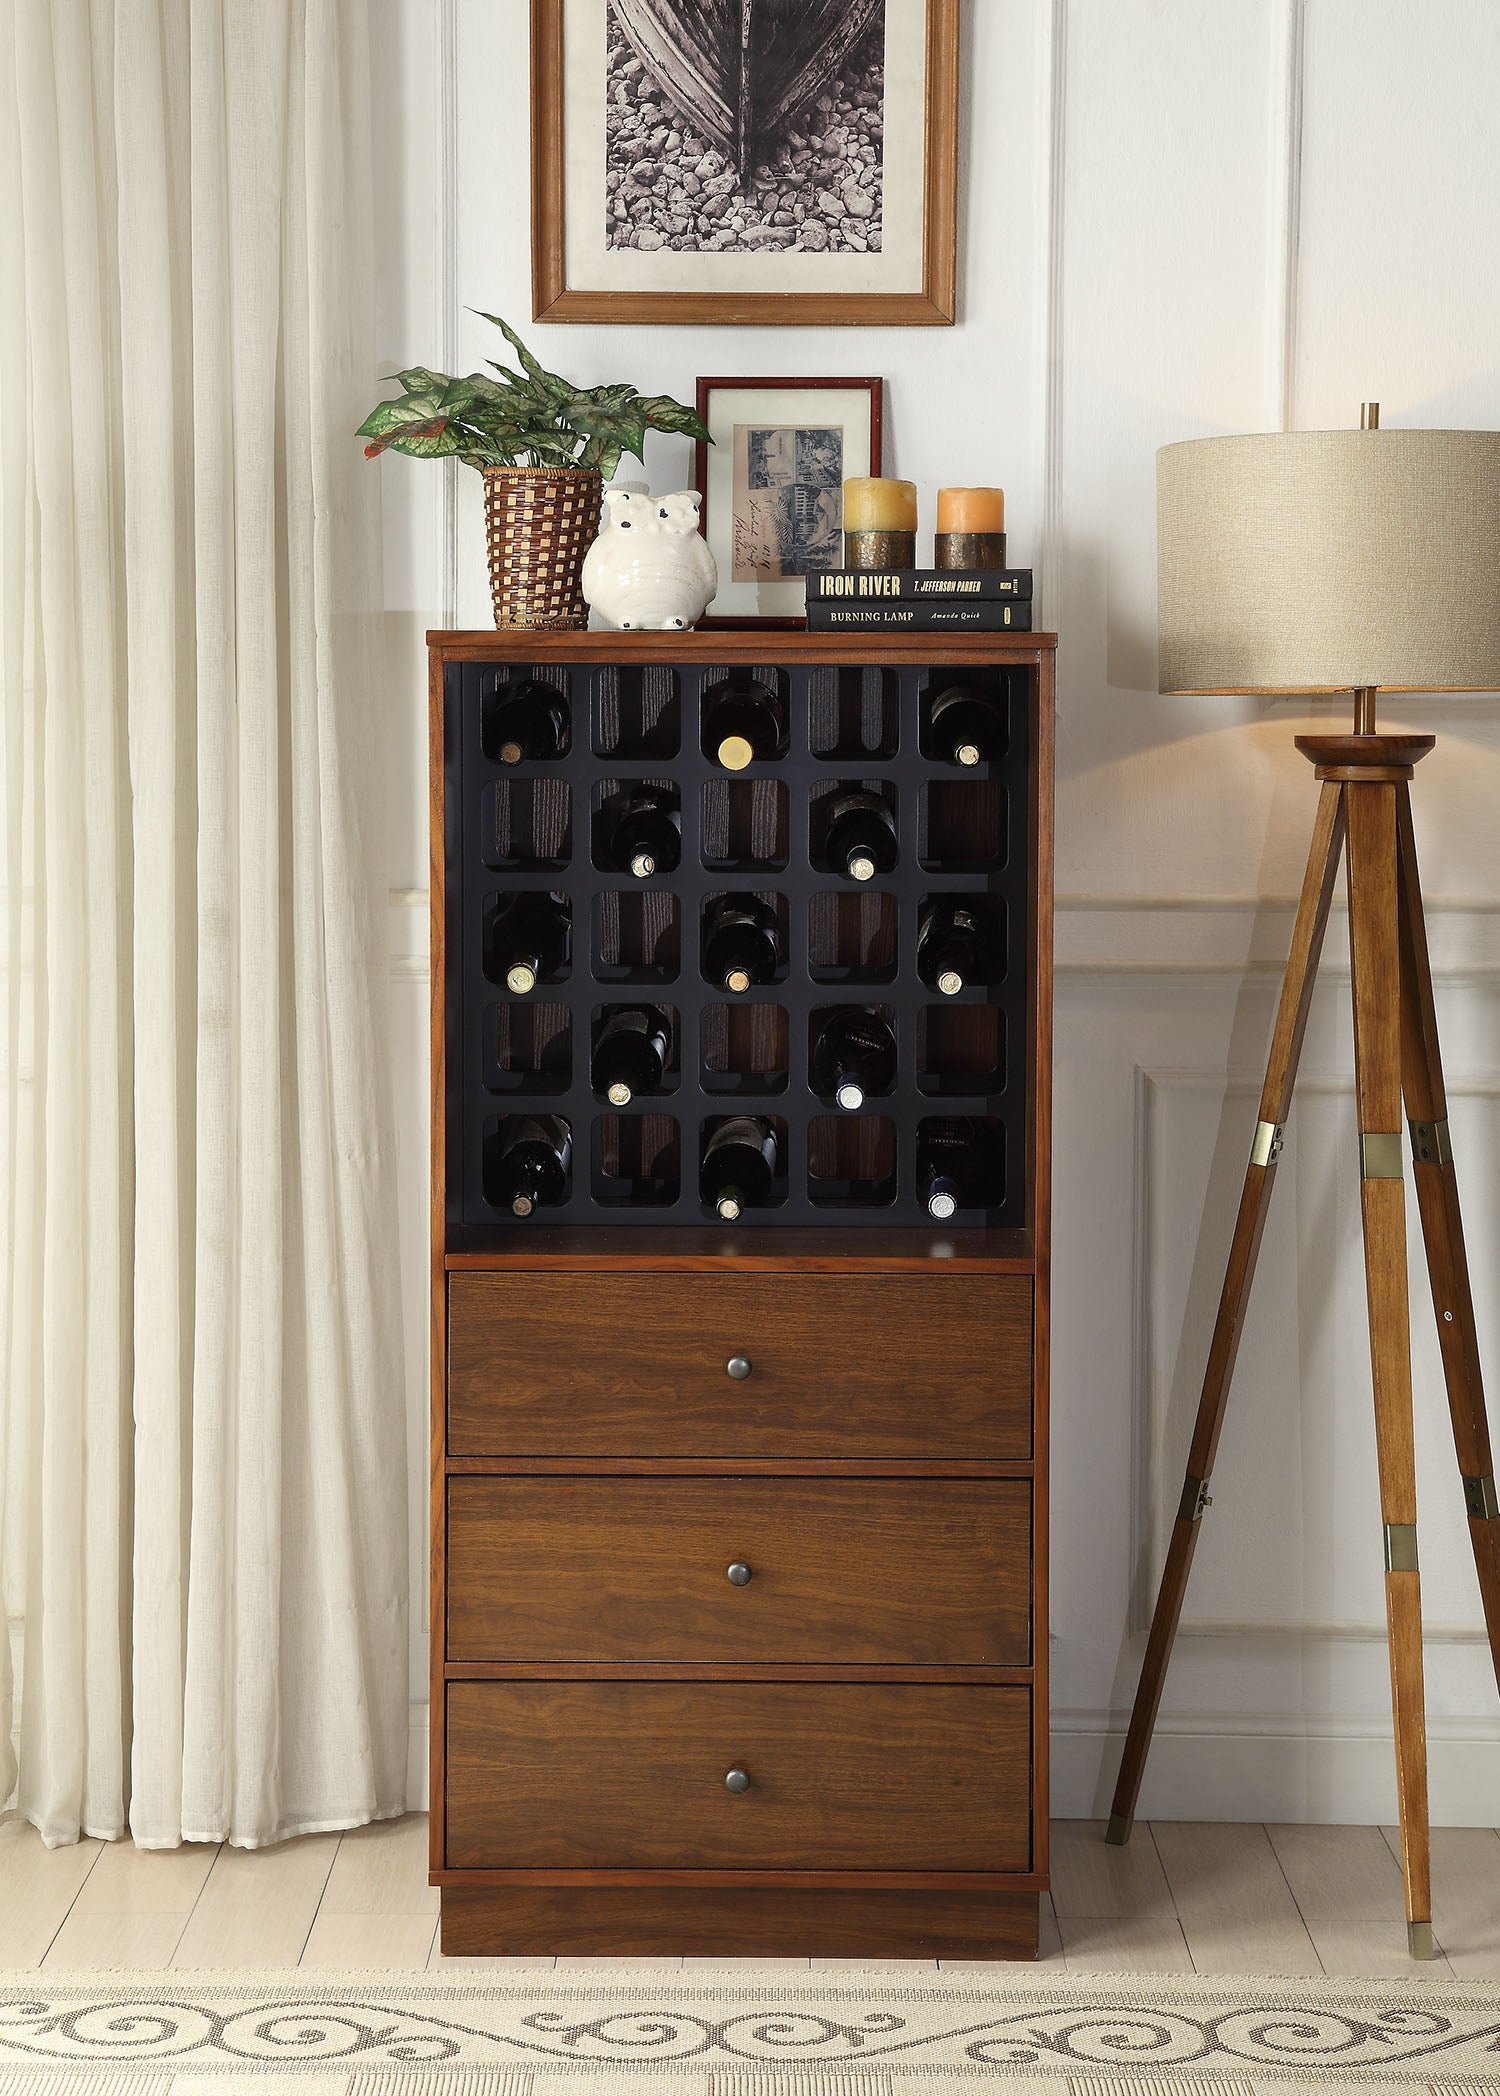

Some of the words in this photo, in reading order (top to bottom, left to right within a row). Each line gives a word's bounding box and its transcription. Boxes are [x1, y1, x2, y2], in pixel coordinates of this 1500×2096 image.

[819, 575, 855, 596] IRON
[858, 575, 901, 596] RIVER
[913, 580, 920, 593] T.
[920, 580, 957, 593] JEFFERSON
[956, 580, 982, 593] PARKER
[830, 611, 881, 622] BURNING
[883, 611, 914, 622] LAMP
[930, 611, 959, 620] Amanda
[960, 611, 980, 621] Quick
